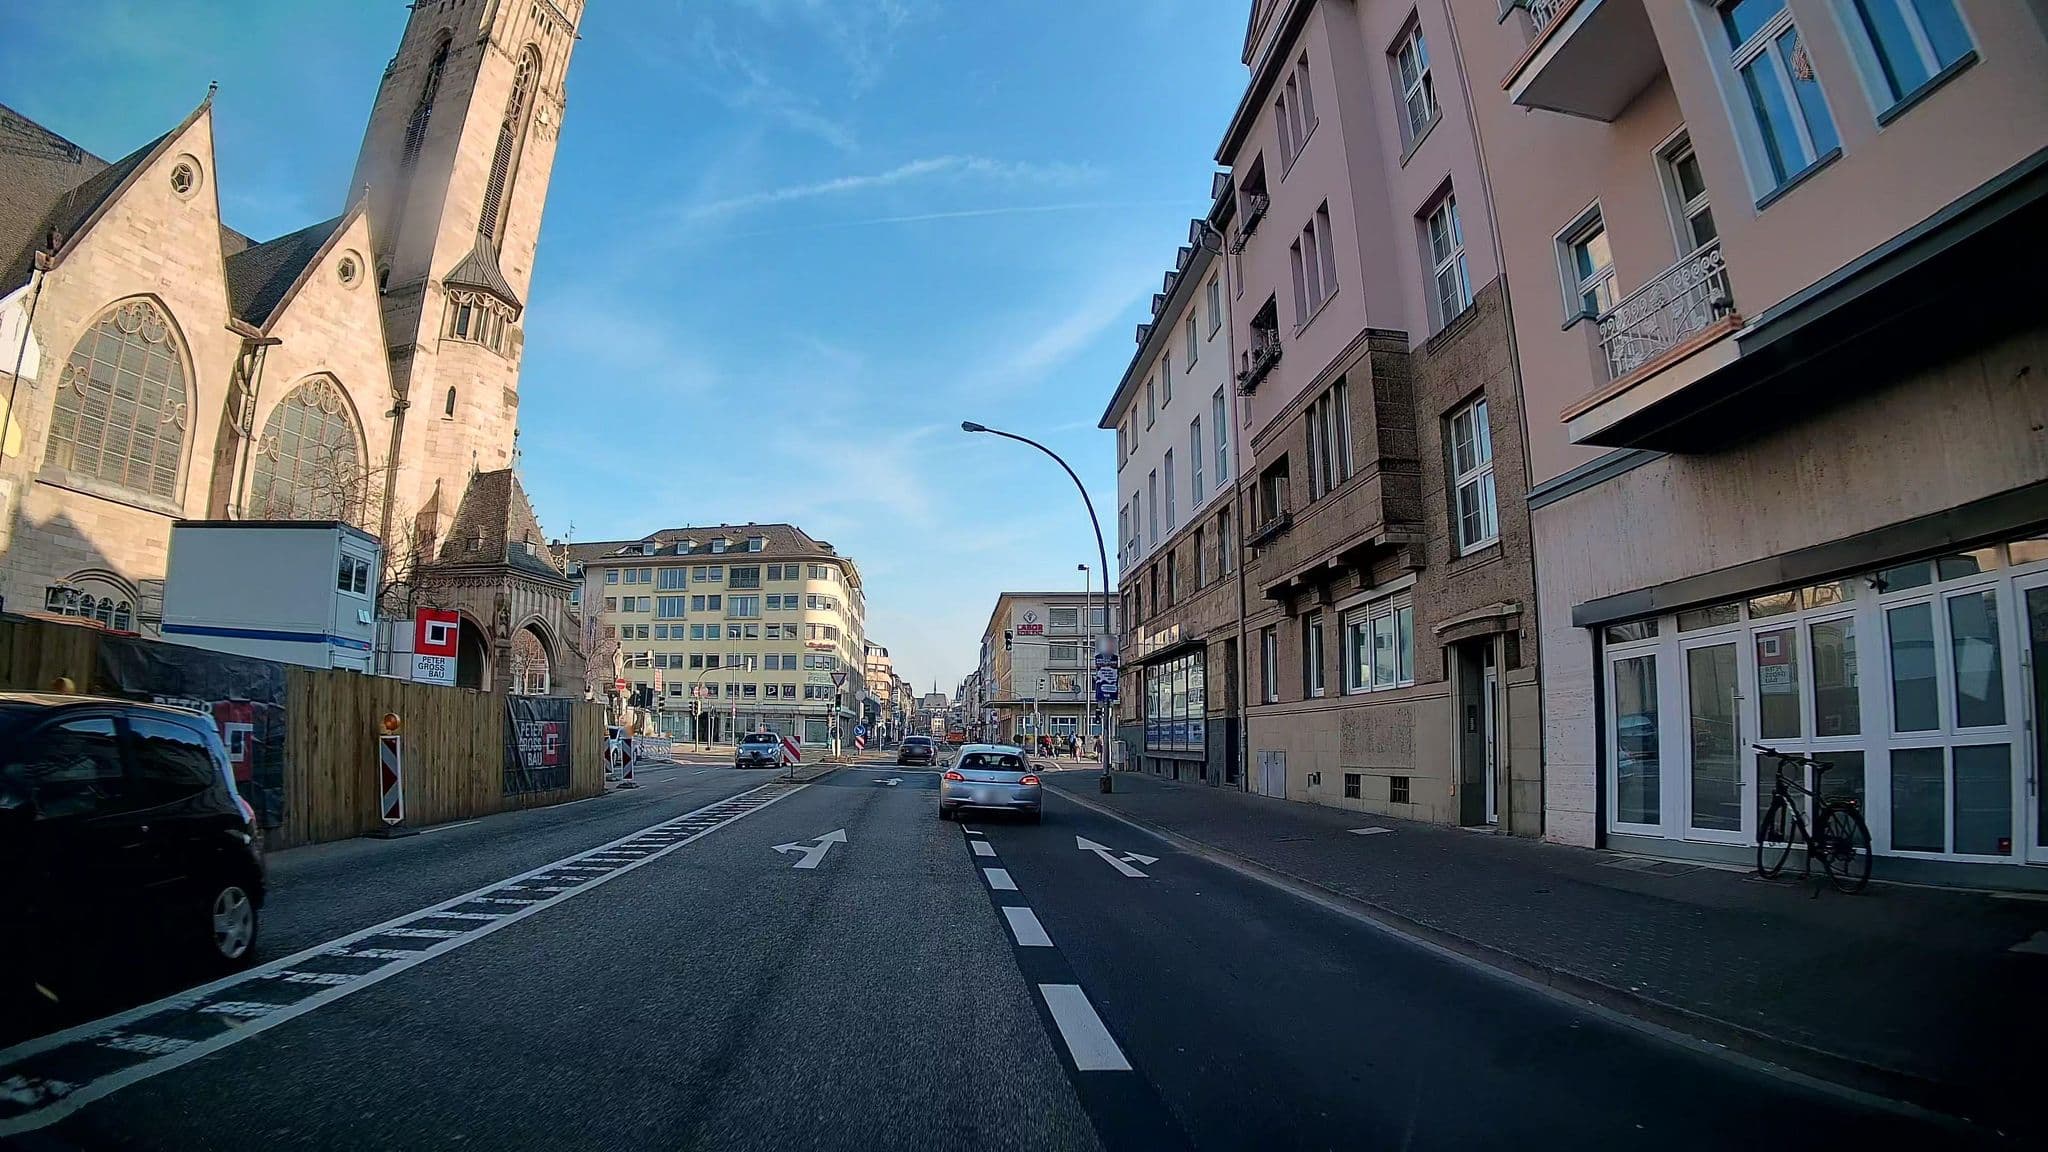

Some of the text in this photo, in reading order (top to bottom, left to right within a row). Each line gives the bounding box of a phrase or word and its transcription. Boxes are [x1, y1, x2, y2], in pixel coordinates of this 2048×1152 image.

[417, 662, 446, 671] GROSS
[422, 656, 446, 664] PETER
[520, 723, 543, 736] PETER
[519, 738, 542, 751] GROSS
[527, 753, 543, 766] BAU
